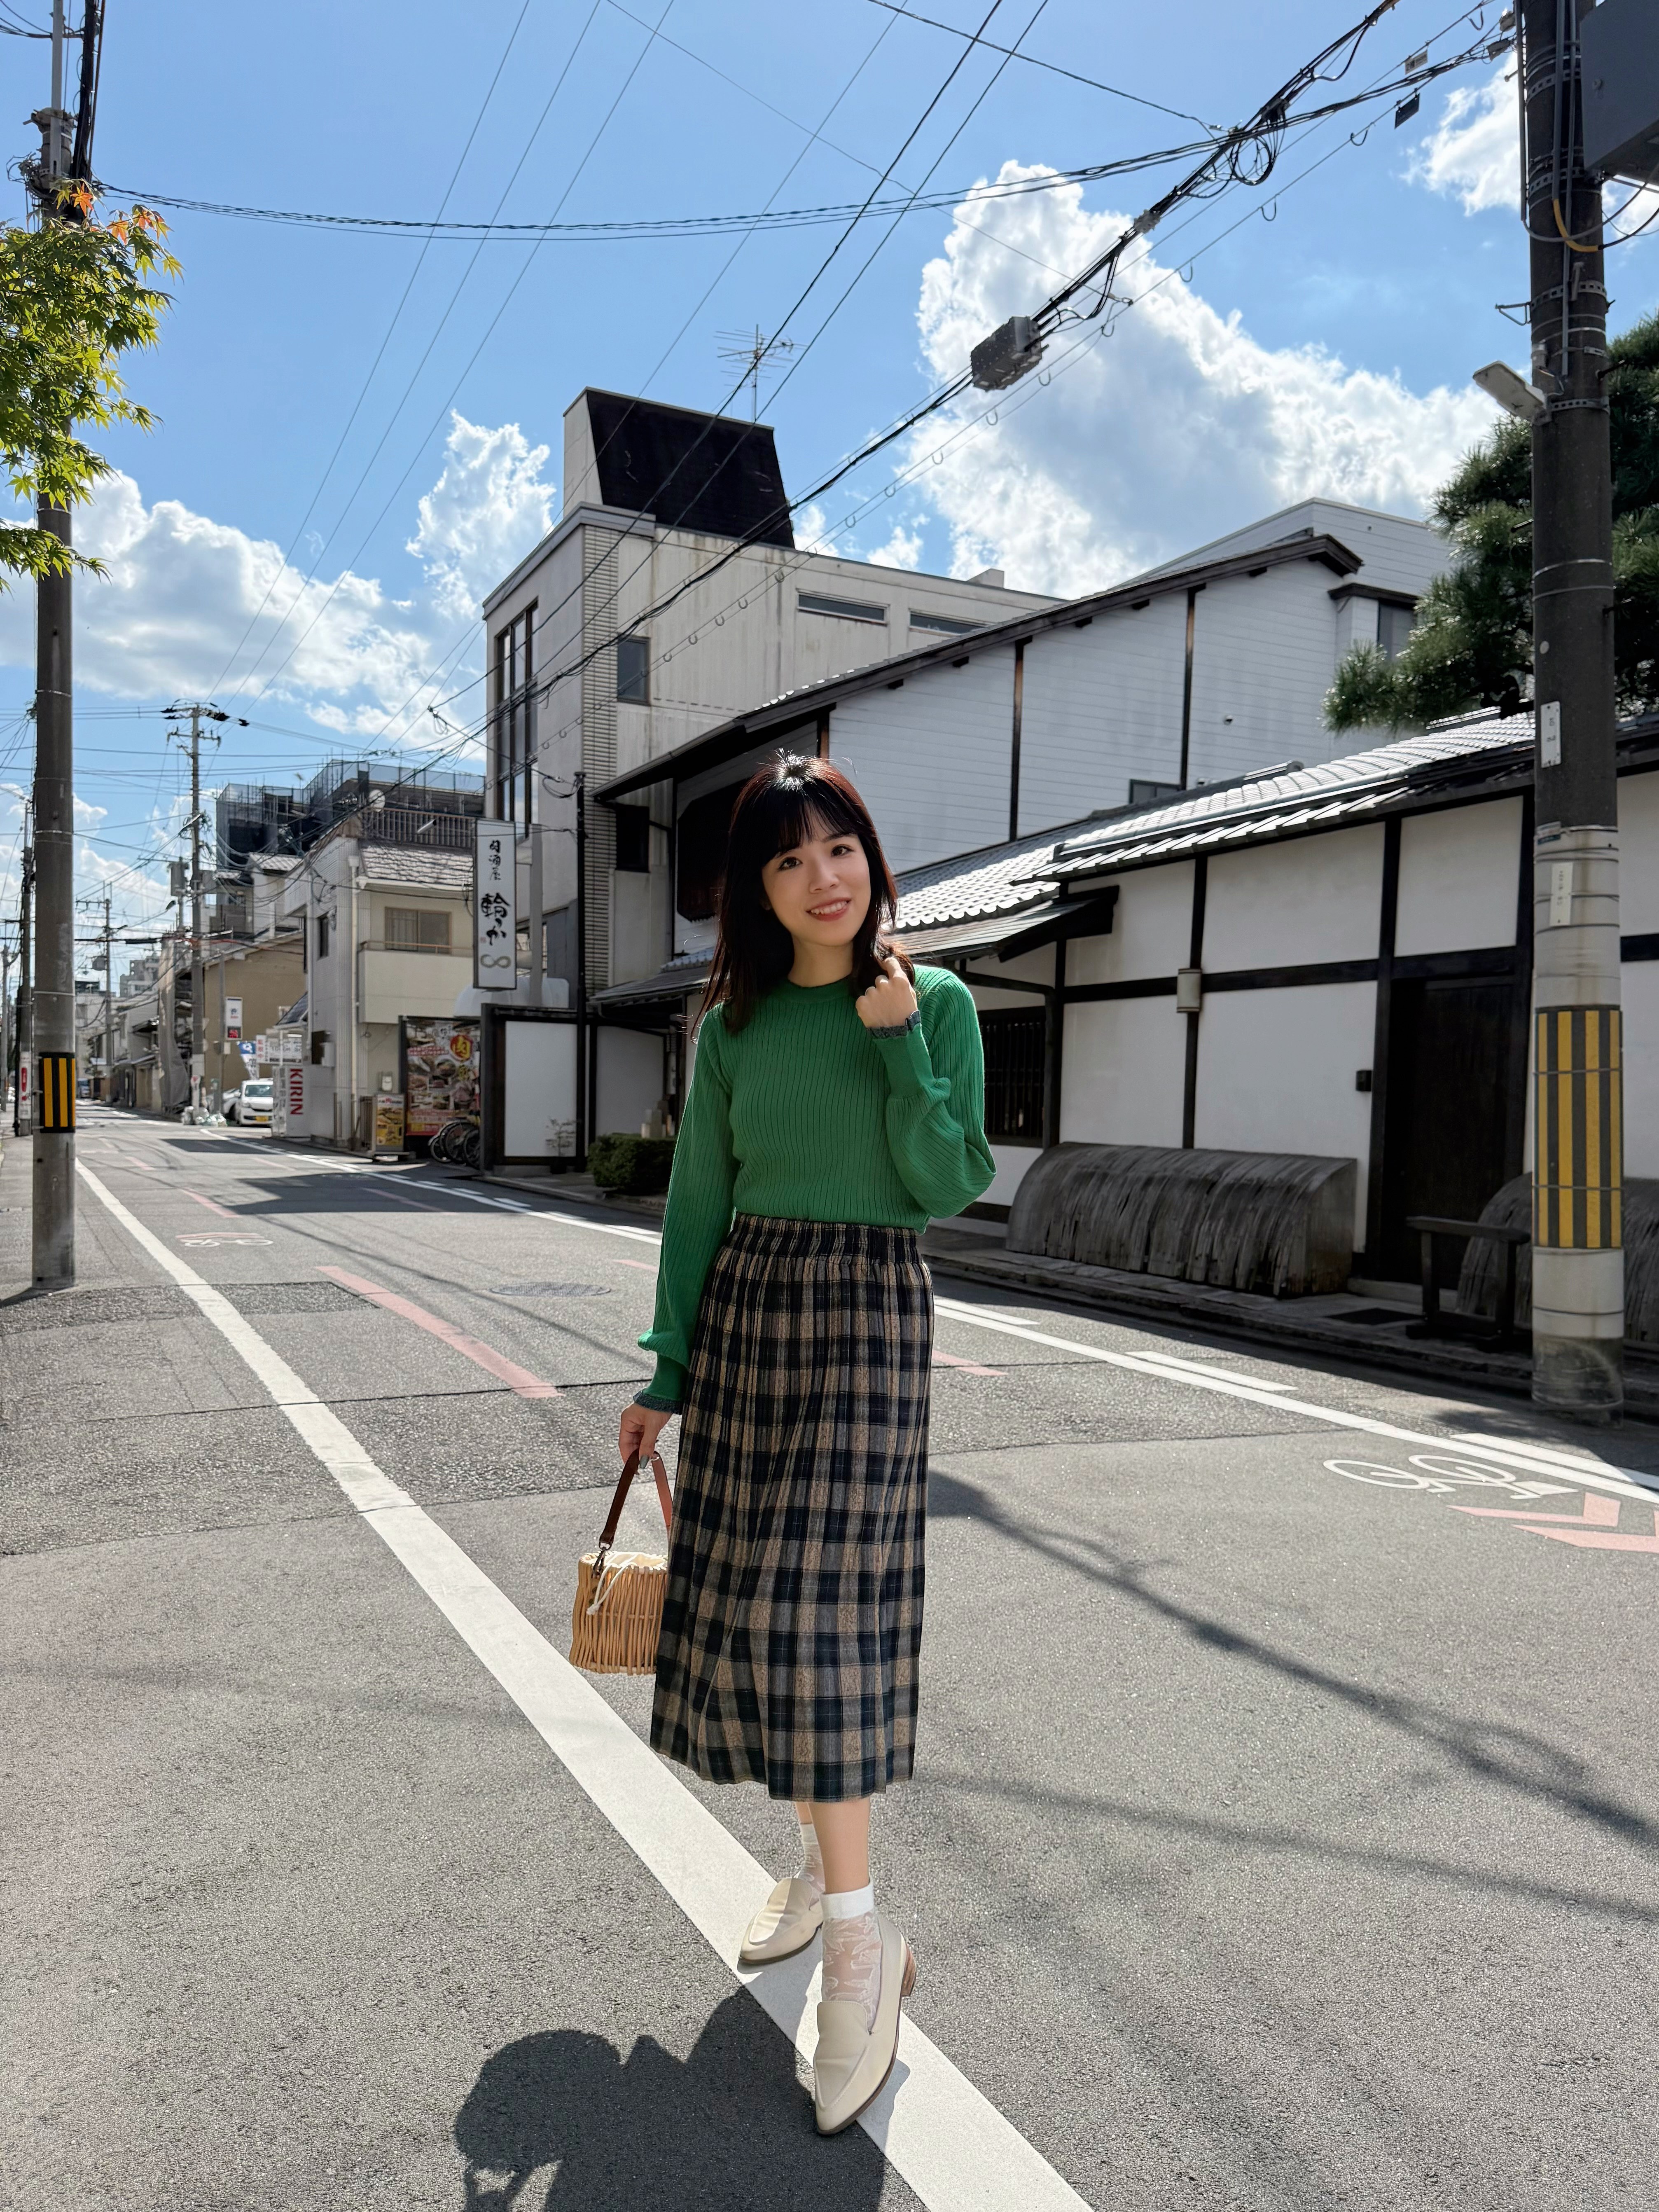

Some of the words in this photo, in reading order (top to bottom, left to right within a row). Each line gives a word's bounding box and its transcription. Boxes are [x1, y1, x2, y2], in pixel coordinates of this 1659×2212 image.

[481, 893, 510, 946] 輪っか
[290, 1069, 303, 1115] KIRIN
